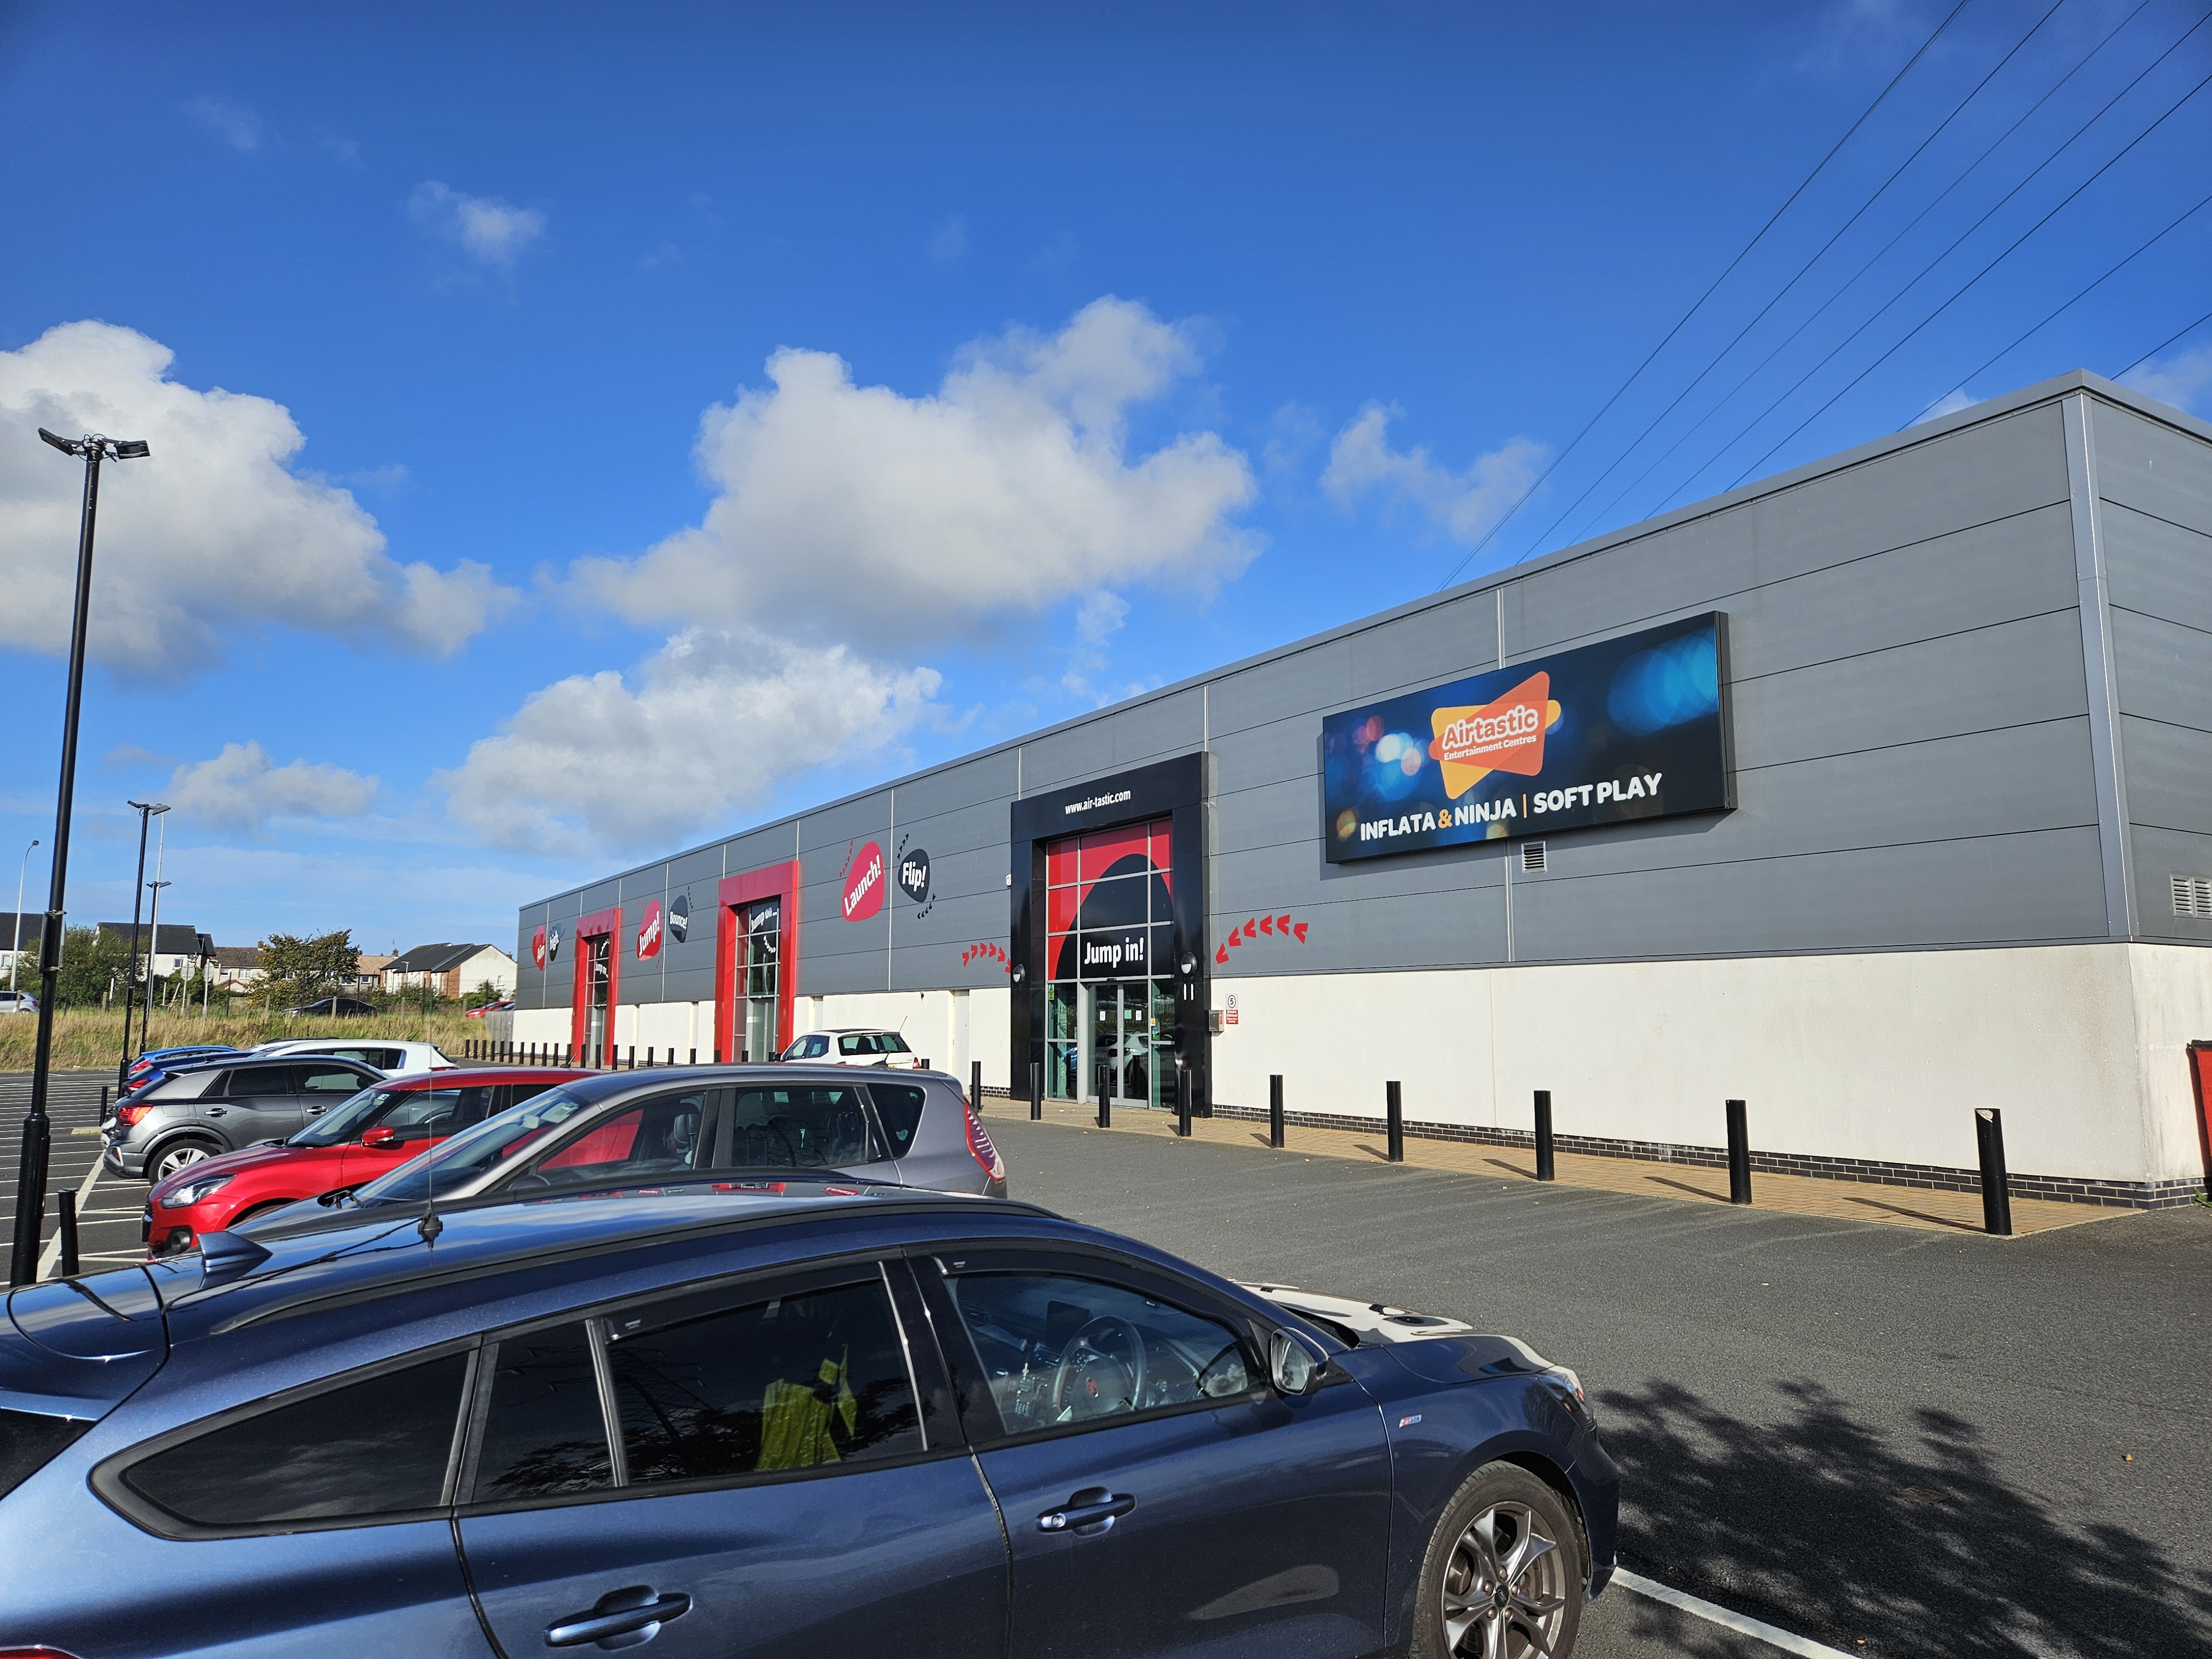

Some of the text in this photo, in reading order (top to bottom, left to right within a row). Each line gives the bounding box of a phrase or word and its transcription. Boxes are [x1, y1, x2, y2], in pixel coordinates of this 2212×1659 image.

[1442, 705, 1538, 750] Airtastic
[1444, 734, 1537, 760] Entertainment Centres
[1065, 790, 1131, 815] www.air-tastic.com
[1360, 773, 1662, 841] INFLATA & NINJA SOFT PLAY
[844, 854, 881, 916] Launch!
[902, 861, 927, 892] Flip!
[639, 910, 660, 957] Jump!
[669, 911, 688, 930] Bounce!
[1084, 937, 1144, 968] Jump in!
